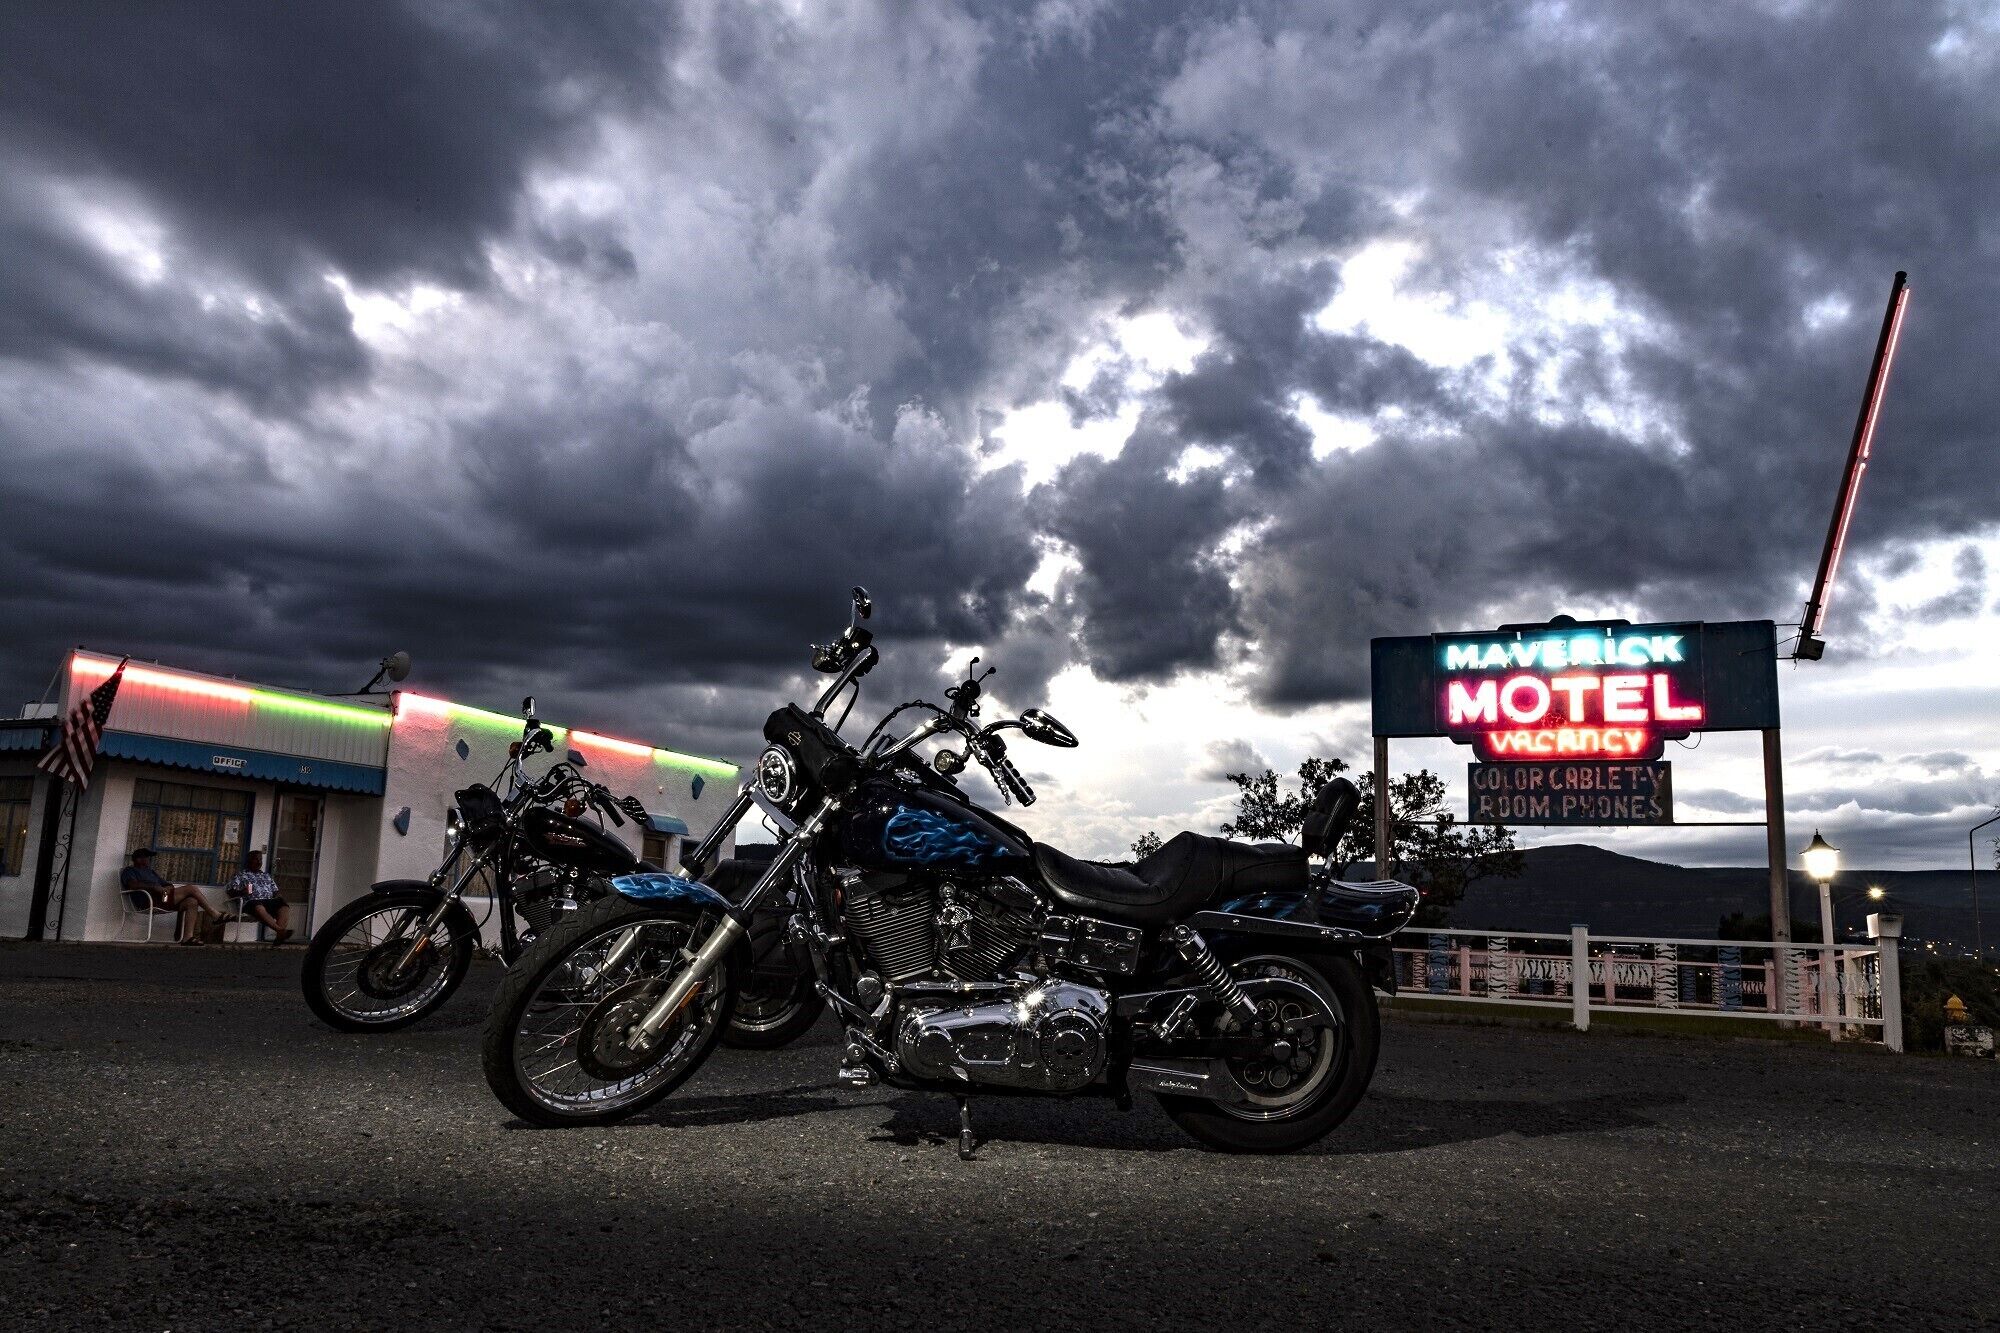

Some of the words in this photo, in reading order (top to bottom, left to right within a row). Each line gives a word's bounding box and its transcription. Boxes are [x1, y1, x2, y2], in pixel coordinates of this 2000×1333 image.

[1448, 674, 1702, 724] MOTEL
[213, 756, 246, 768] OFFICE
[1473, 767, 1544, 791] COLOR
[1480, 795, 1550, 818] ROOM
[1562, 795, 1664, 819] PHONES
